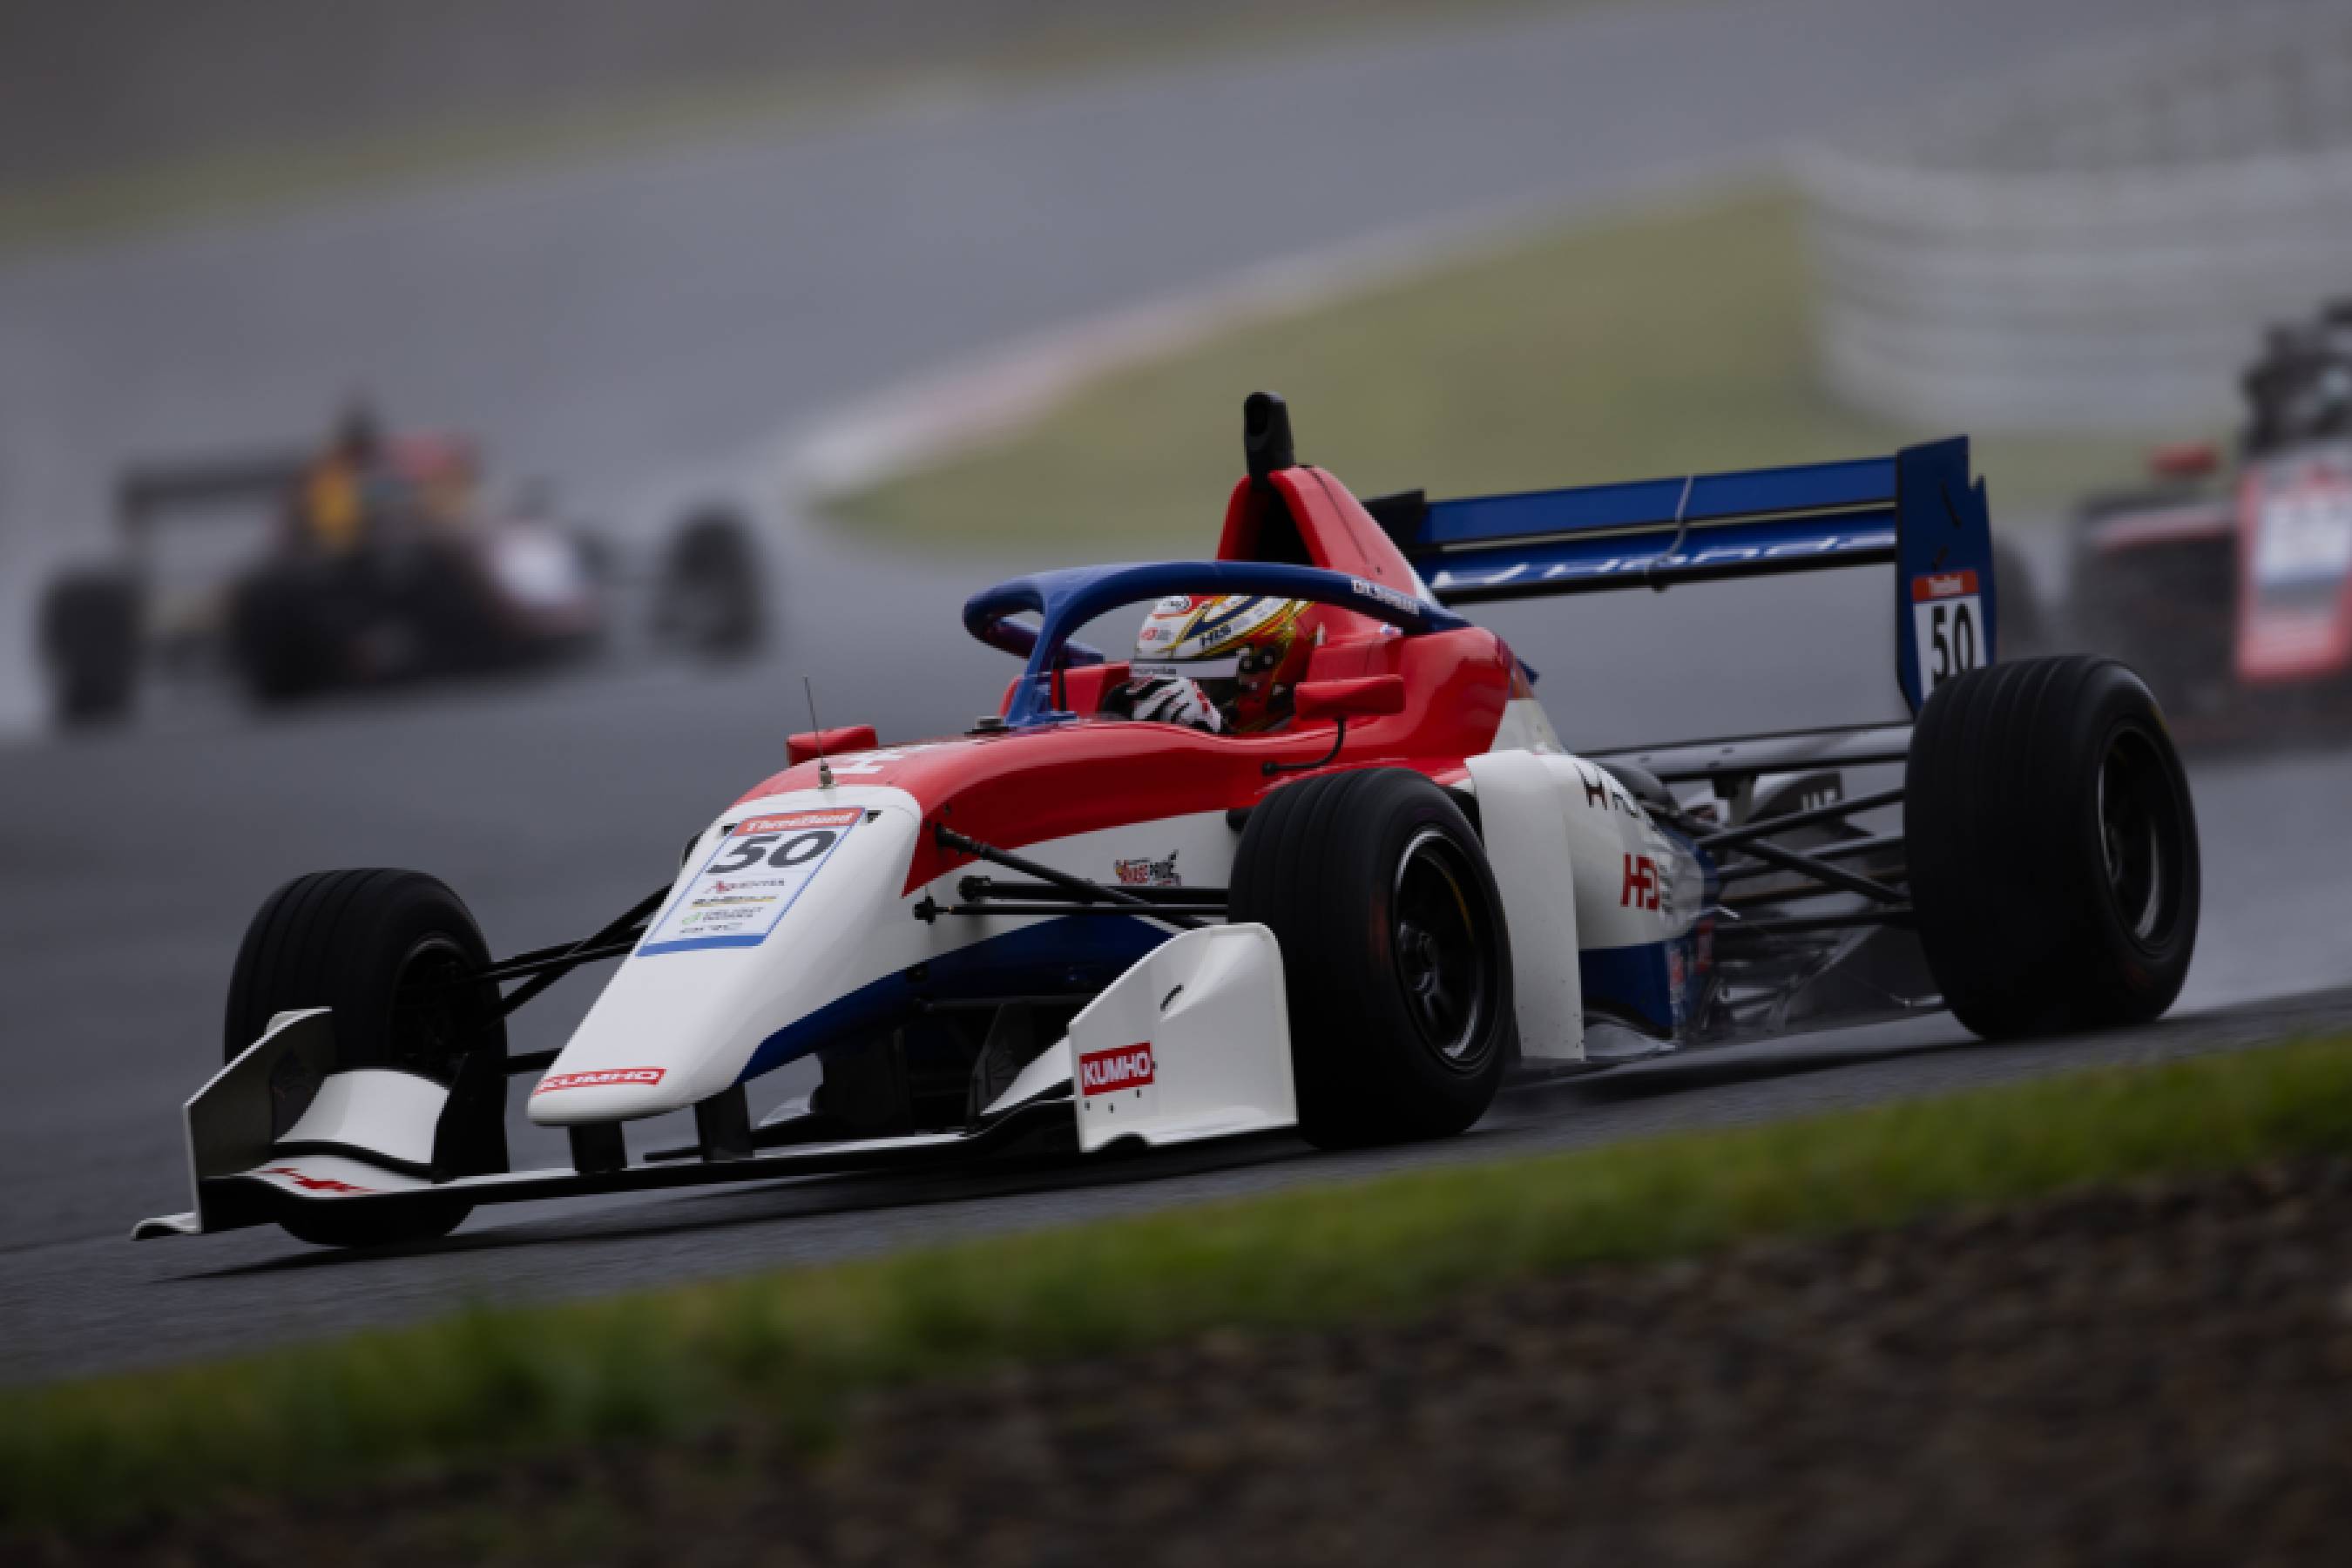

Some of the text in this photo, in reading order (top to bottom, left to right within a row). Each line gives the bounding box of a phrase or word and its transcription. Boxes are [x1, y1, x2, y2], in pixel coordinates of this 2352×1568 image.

[1931, 603, 1974, 682] 50
[706, 830, 837, 874] 50
[537, 1071, 659, 1090] KUMHO
[1082, 1051, 1150, 1087] KUMHO
